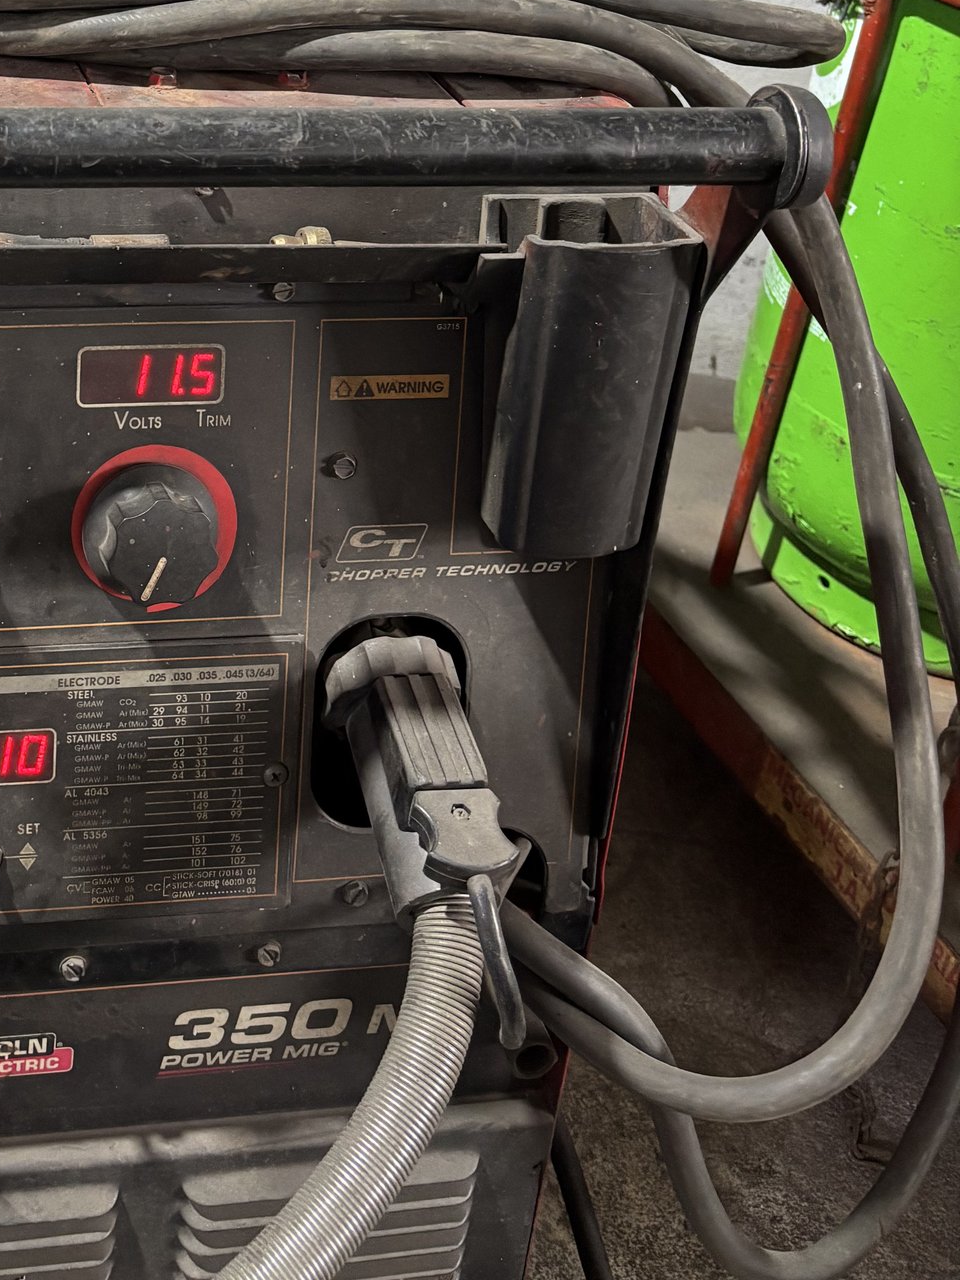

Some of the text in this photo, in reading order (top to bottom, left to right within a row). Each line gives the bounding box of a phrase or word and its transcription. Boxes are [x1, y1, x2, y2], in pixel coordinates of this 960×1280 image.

[136, 353, 215, 396] 11.5
[376, 381, 445, 394] WARNING
[113, 409, 231, 430] VOLTS TRIM
[349, 528, 416, 557] CT
[328, 559, 577, 582] CHOPPER TECHNOLOGY
[57, 675, 121, 688] ELECTRODE
[146, 673, 167, 683] .025
[170, 672, 192, 682] .030
[196, 670, 218, 680] .035
[223, 669, 244, 679] .045
[76, 700, 104, 708] GMAW
[176, 694, 188, 703] 93
[200, 693, 211, 702] 10
[236, 691, 248, 700] 20
[76, 711, 104, 719] GMAW
[153, 706, 165, 716] 29
[176, 706, 188, 714] 94
[200, 705, 209, 713] 11
[151, 718, 164, 727] 30
[175, 717, 187, 726] 95
[200, 716, 210, 725] 14
[66, 733, 118, 744] STAINLESS
[174, 737, 185, 746] 61
[197, 736, 208, 745] 31
[233, 734, 244, 743] 41
[0, 734, 47, 776] 10
[173, 748, 185, 757] 62
[232, 745, 245, 754] 42
[64, 787, 110, 798] AL 4043
[231, 789, 242, 797] 71
[231, 800, 242, 808] 72
[230, 810, 242, 818] 99
[17, 822, 41, 835] SET
[63, 830, 108, 841] AL 5356
[191, 835, 205, 844] 151
[230, 833, 241, 842] 75
[191, 847, 207, 856] 152
[230, 845, 242, 854] 76
[191, 858, 206, 867] 101
[230, 856, 246, 865] 102
[92, 877, 121, 886] GMAW
[145, 883, 161, 892] CC
[168, 998, 353, 1050] 350
[160, 1041, 341, 1070] POWER MIG
